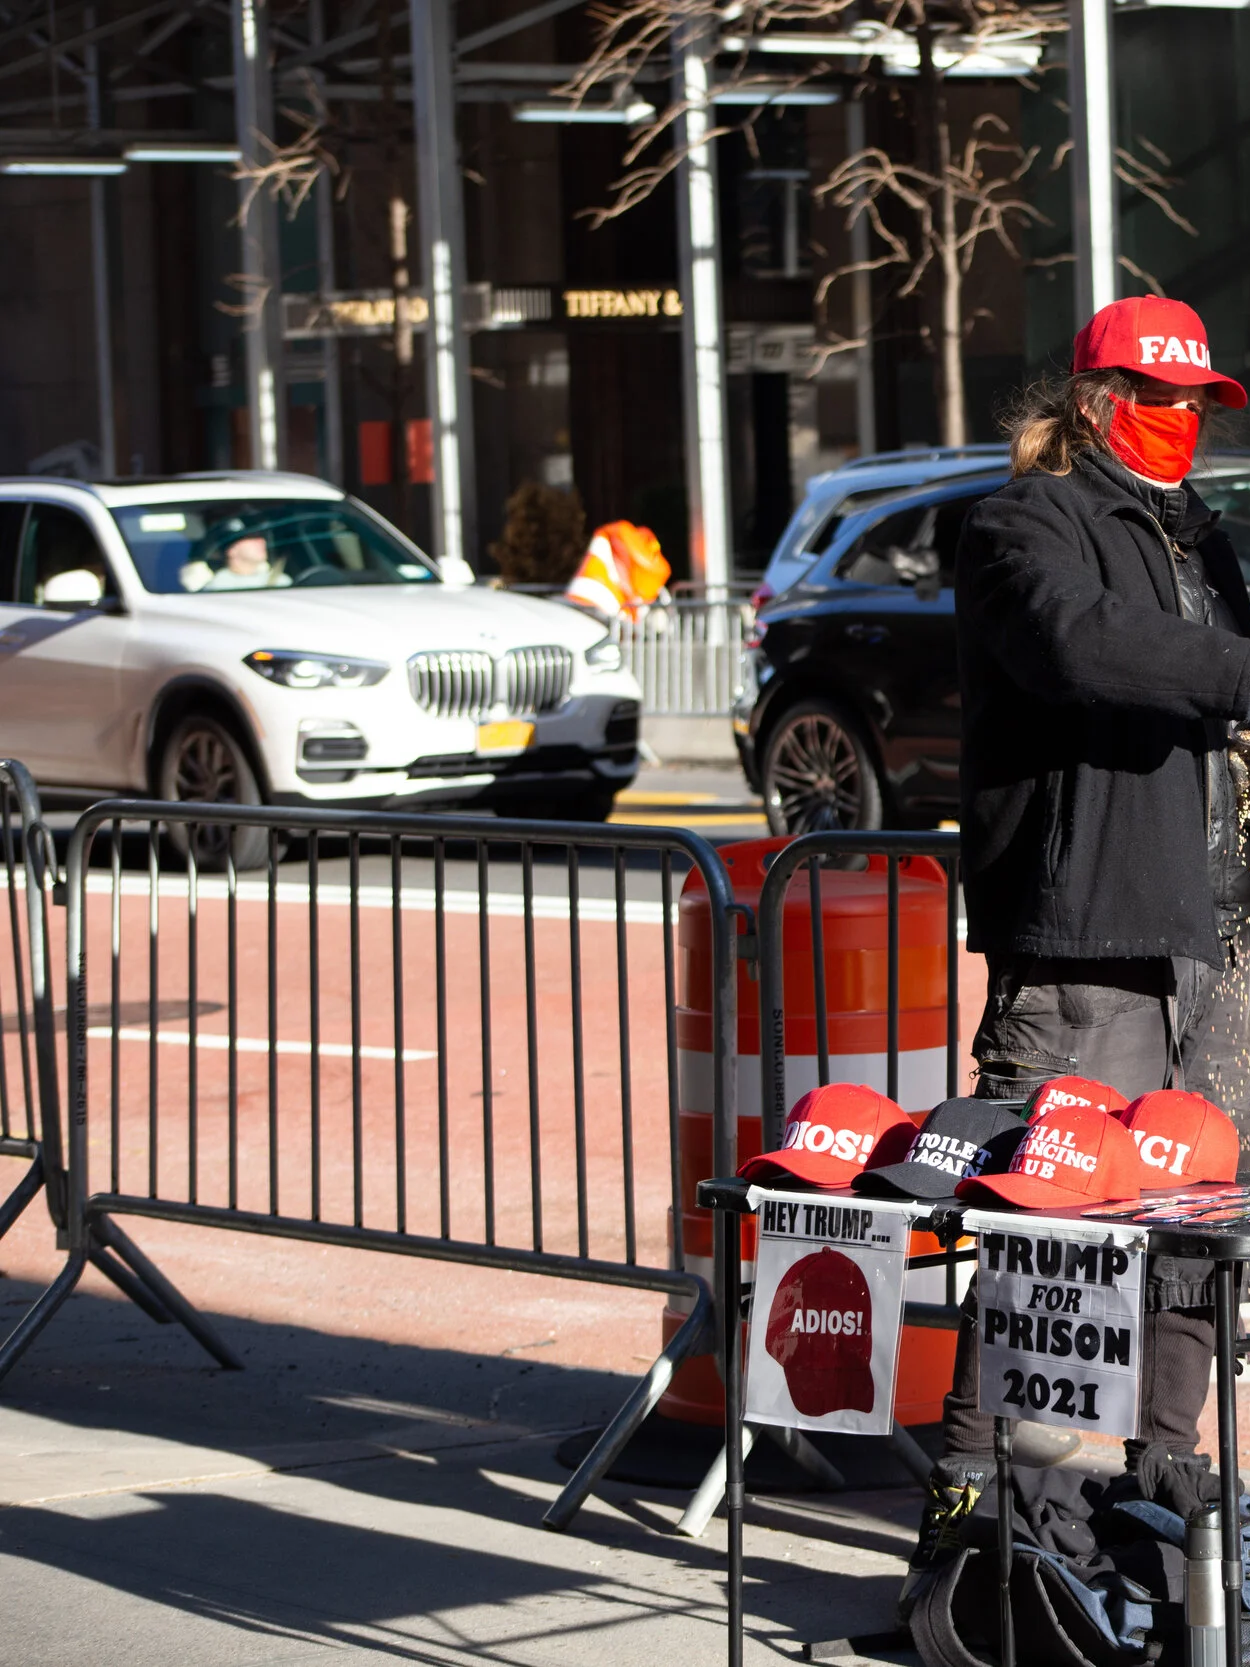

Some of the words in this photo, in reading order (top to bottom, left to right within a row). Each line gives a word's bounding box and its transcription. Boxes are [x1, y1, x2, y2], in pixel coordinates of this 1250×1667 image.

[563, 290, 661, 317] TIFFANY
[1138, 336, 1211, 371] FAU
[914, 1148, 982, 1179] AGAIN
[918, 1133, 992, 1165] TOILET
[763, 1200, 800, 1234] HEY
[983, 1233, 1129, 1287] TRUMP
[1027, 1284, 1082, 1314] FOR
[791, 1309, 863, 1336] ADIOS!
[984, 1308, 1131, 1366] PRISON
[1003, 1369, 1101, 1420] 2021
